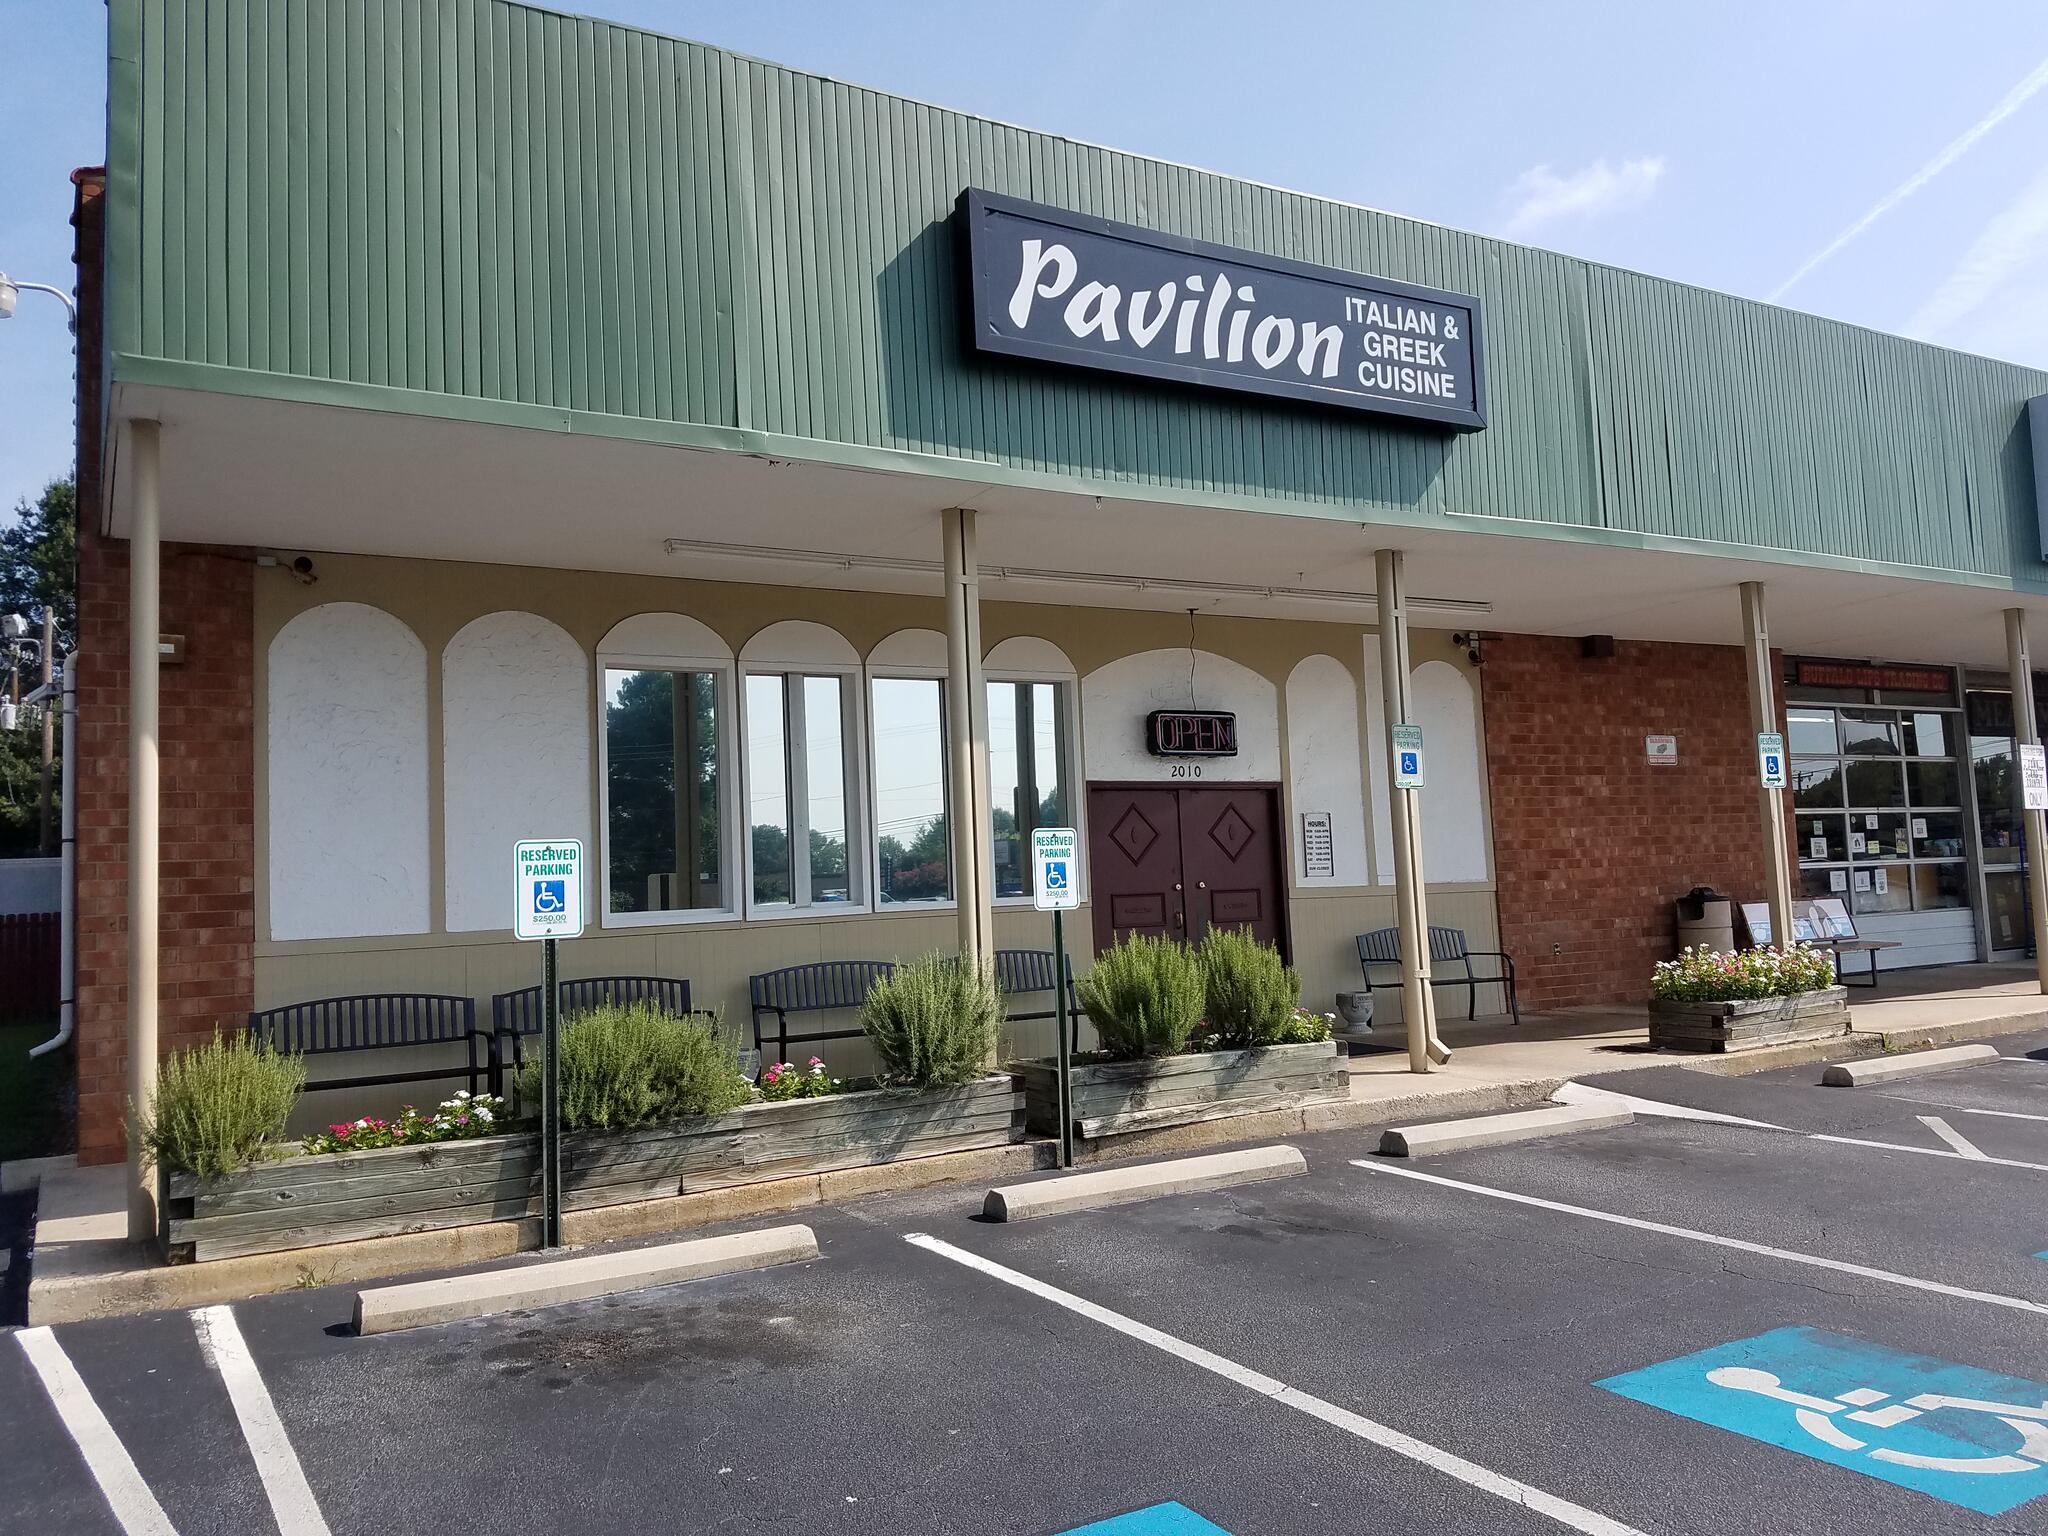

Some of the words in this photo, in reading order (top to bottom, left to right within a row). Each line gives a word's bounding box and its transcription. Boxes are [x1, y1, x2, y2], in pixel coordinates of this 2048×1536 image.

[1008, 238, 1344, 379] Pavilion
[1345, 296, 1436, 336] ITALIAN
[1443, 315, 1460, 340] &
[1363, 331, 1447, 367] GREEK
[1358, 361, 1456, 398] CUISINE
[1155, 716, 1234, 750] OPEN
[1394, 731, 1420, 740] RESERVED
[1396, 741, 1420, 750] PARKING
[1171, 765, 1202, 777] 2010
[1036, 836, 1073, 846] RESERVED
[521, 849, 576, 861] RESERVED
[1039, 848, 1071, 858] PARKING
[525, 863, 573, 876] PARKING
